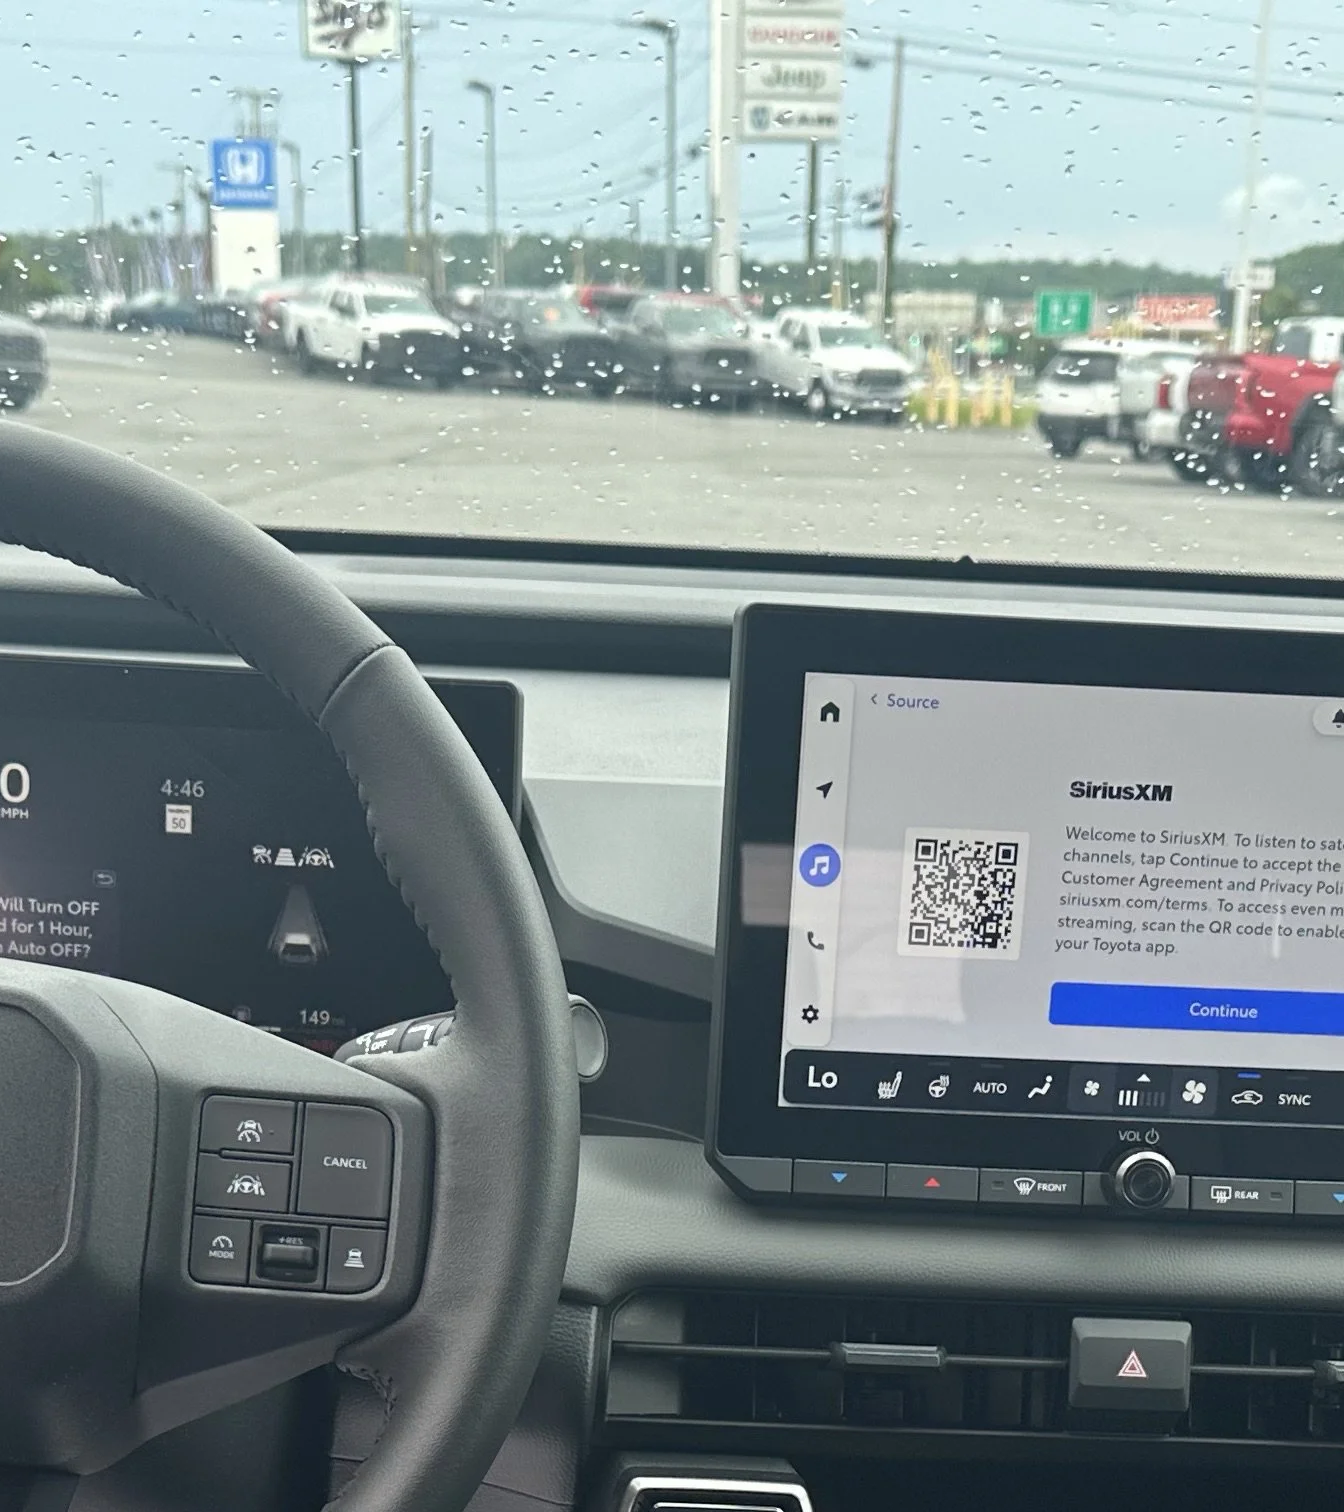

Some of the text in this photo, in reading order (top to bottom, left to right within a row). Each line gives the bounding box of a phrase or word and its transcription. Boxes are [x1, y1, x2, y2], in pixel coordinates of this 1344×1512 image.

[886, 693, 940, 709] Source
[0, 763, 30, 803] 0
[160, 779, 205, 797] 4:46
[1069, 781, 1173, 802] SiriusXM
[0, 808, 29, 819] MPH
[172, 817, 186, 829] 50
[1065, 826, 1136, 843] Welcome
[1141, 831, 1155, 843] to
[1234, 833, 1251, 847] To
[1255, 834, 1296, 850] listen
[1301, 837, 1316, 850] to
[1063, 848, 1136, 866] channels,
[1140, 853, 1165, 868] tap
[1169, 852, 1238, 869] Continue
[1243, 857, 1258, 869] to
[1262, 859, 1313, 874] accept
[1317, 858, 1341, 873] the
[1061, 870, 1135, 887] Customer
[1139, 874, 1223, 891] Agreement
[1226, 878, 1256, 892] and
[1260, 878, 1313, 897] Privacy
[28, 899, 63, 914] Turn
[68, 901, 100, 916] OFF
[1217, 898, 1233, 912] To
[1238, 902, 1286, 915] access
[1291, 904, 1326, 916] even
[11, 918, 34, 934] for
[38, 921, 45, 934] 1
[50, 922, 93, 939] Hour,
[7, 941, 46, 956] Auto
[50, 942, 91, 958] OFF?
[299, 1009, 330, 1025] 149
[1189, 1002, 1258, 1019] Continue
[807, 1065, 838, 1089] Lo
[972, 1081, 1007, 1095] AUTO
[1278, 1093, 1311, 1107] SYNC
[1118, 1130, 1141, 1142] VOL
[323, 1156, 368, 1170] CANCEL
[1037, 1181, 1067, 1193] FRONT
[1234, 1189, 1259, 1201] REAR
[208, 1250, 235, 1260] MODE
